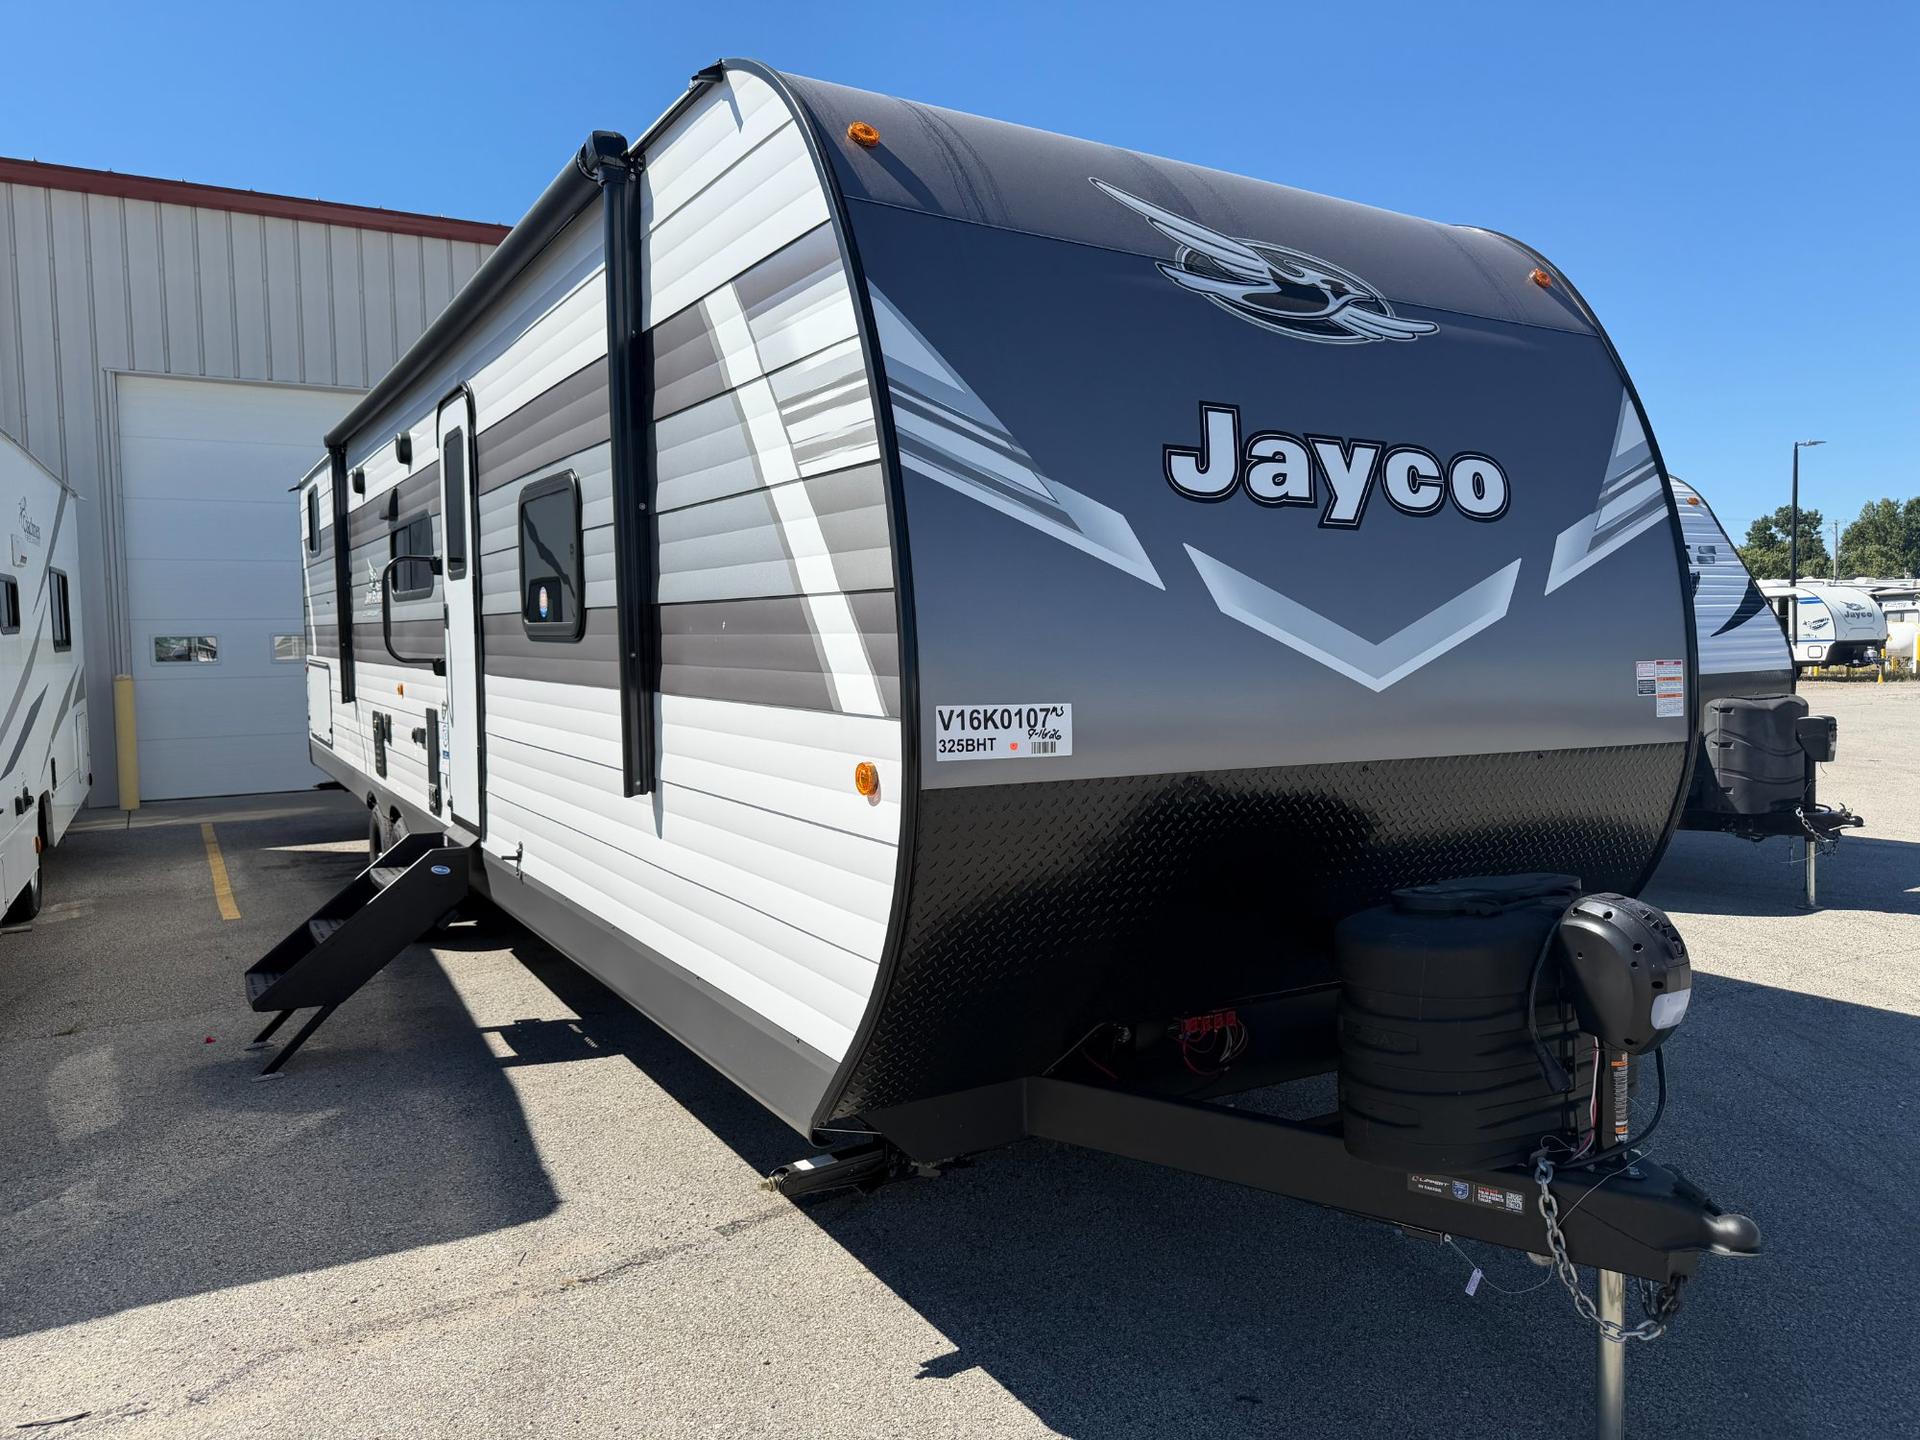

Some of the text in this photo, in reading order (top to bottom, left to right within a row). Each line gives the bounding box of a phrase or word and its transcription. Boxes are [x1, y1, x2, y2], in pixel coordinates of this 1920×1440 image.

[1163, 401, 1512, 531] Jayco
[1844, 610, 1873, 619] Jayco
[937, 707, 1051, 731] V16K0107
[938, 737, 997, 753] 325BHT
